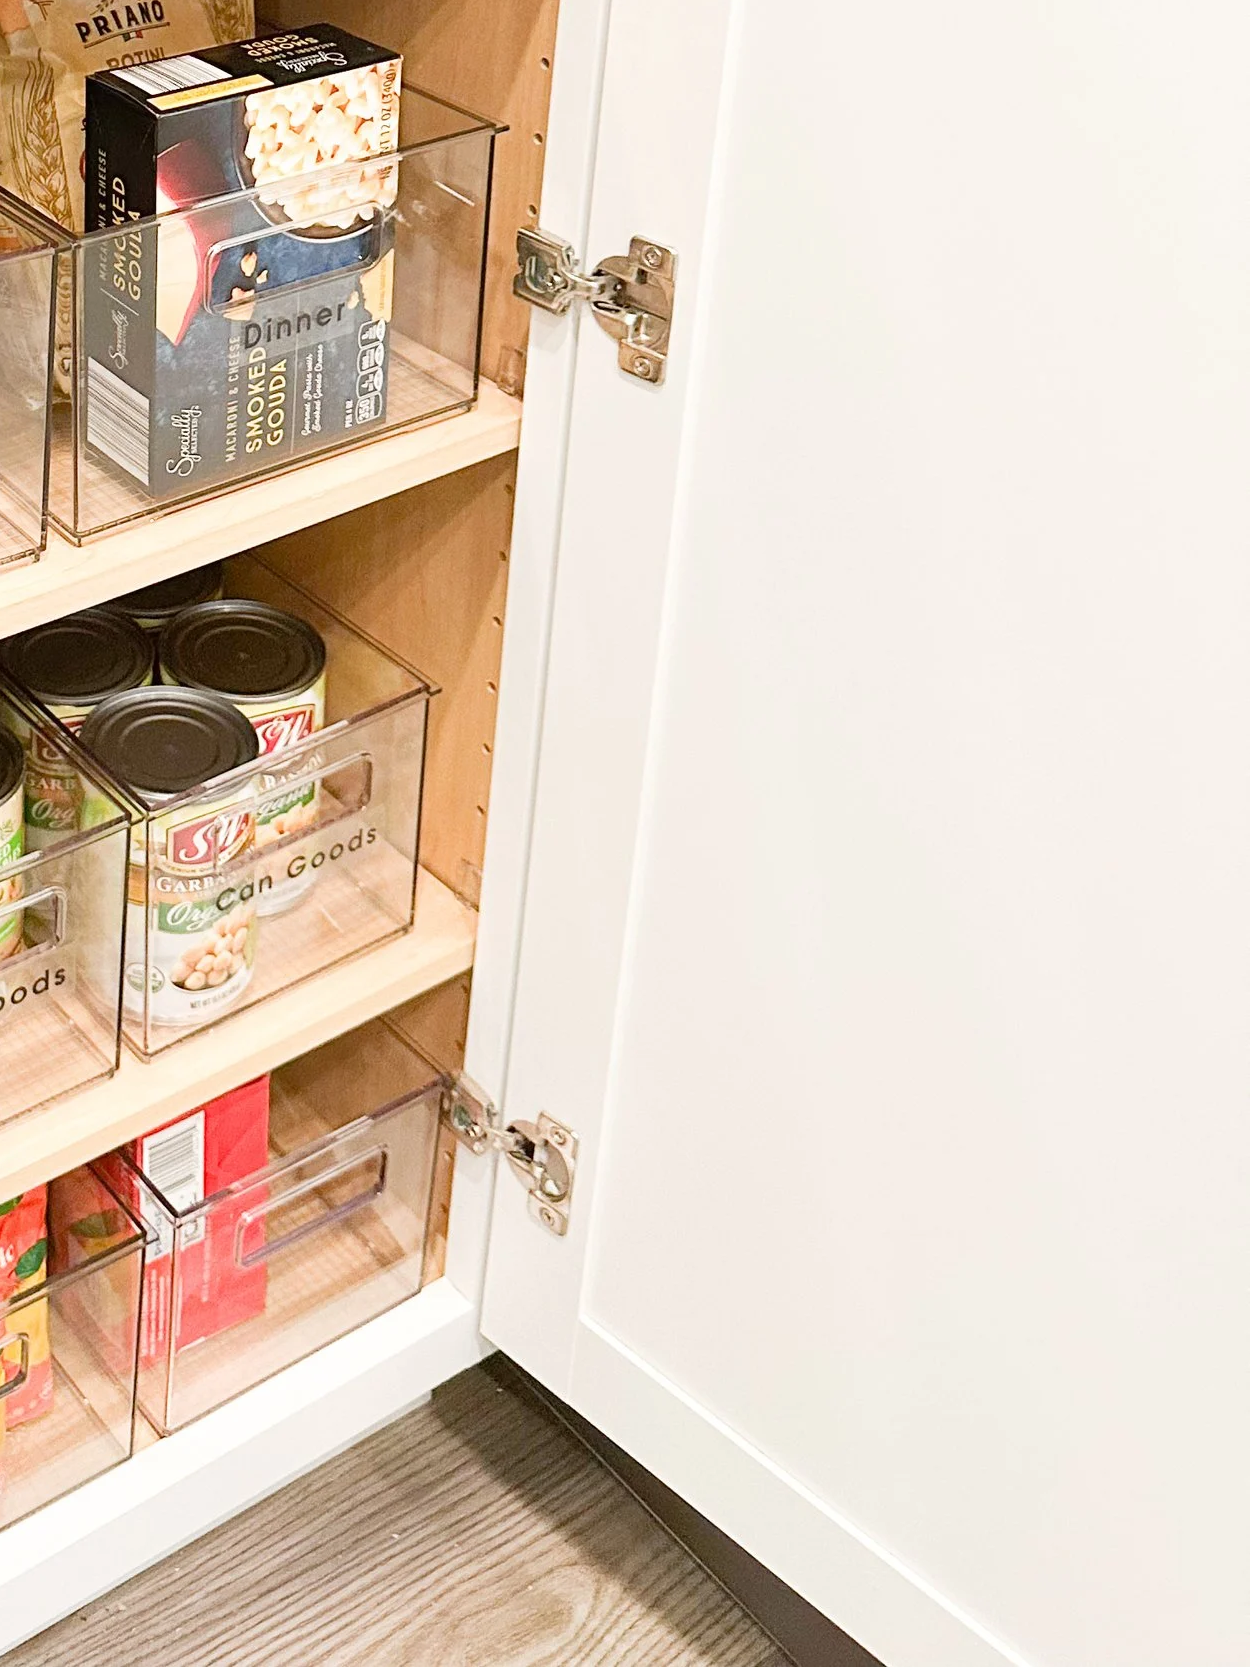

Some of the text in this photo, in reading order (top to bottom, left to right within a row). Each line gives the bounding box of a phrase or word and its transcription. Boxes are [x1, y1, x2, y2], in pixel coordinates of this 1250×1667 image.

[75, 0, 165, 43] PRIANO
[240, 34, 299, 49] GOUDA
[247, 37, 319, 56] SMOKED
[244, 302, 345, 350] Dinner
[226, 335, 241, 462] MACARONI & CHEESE
[246, 347, 266, 454] SMOKED
[266, 358, 287, 446] GOUDA
[166, 405, 202, 477] Specially
[216, 827, 378, 912] Can Goods
